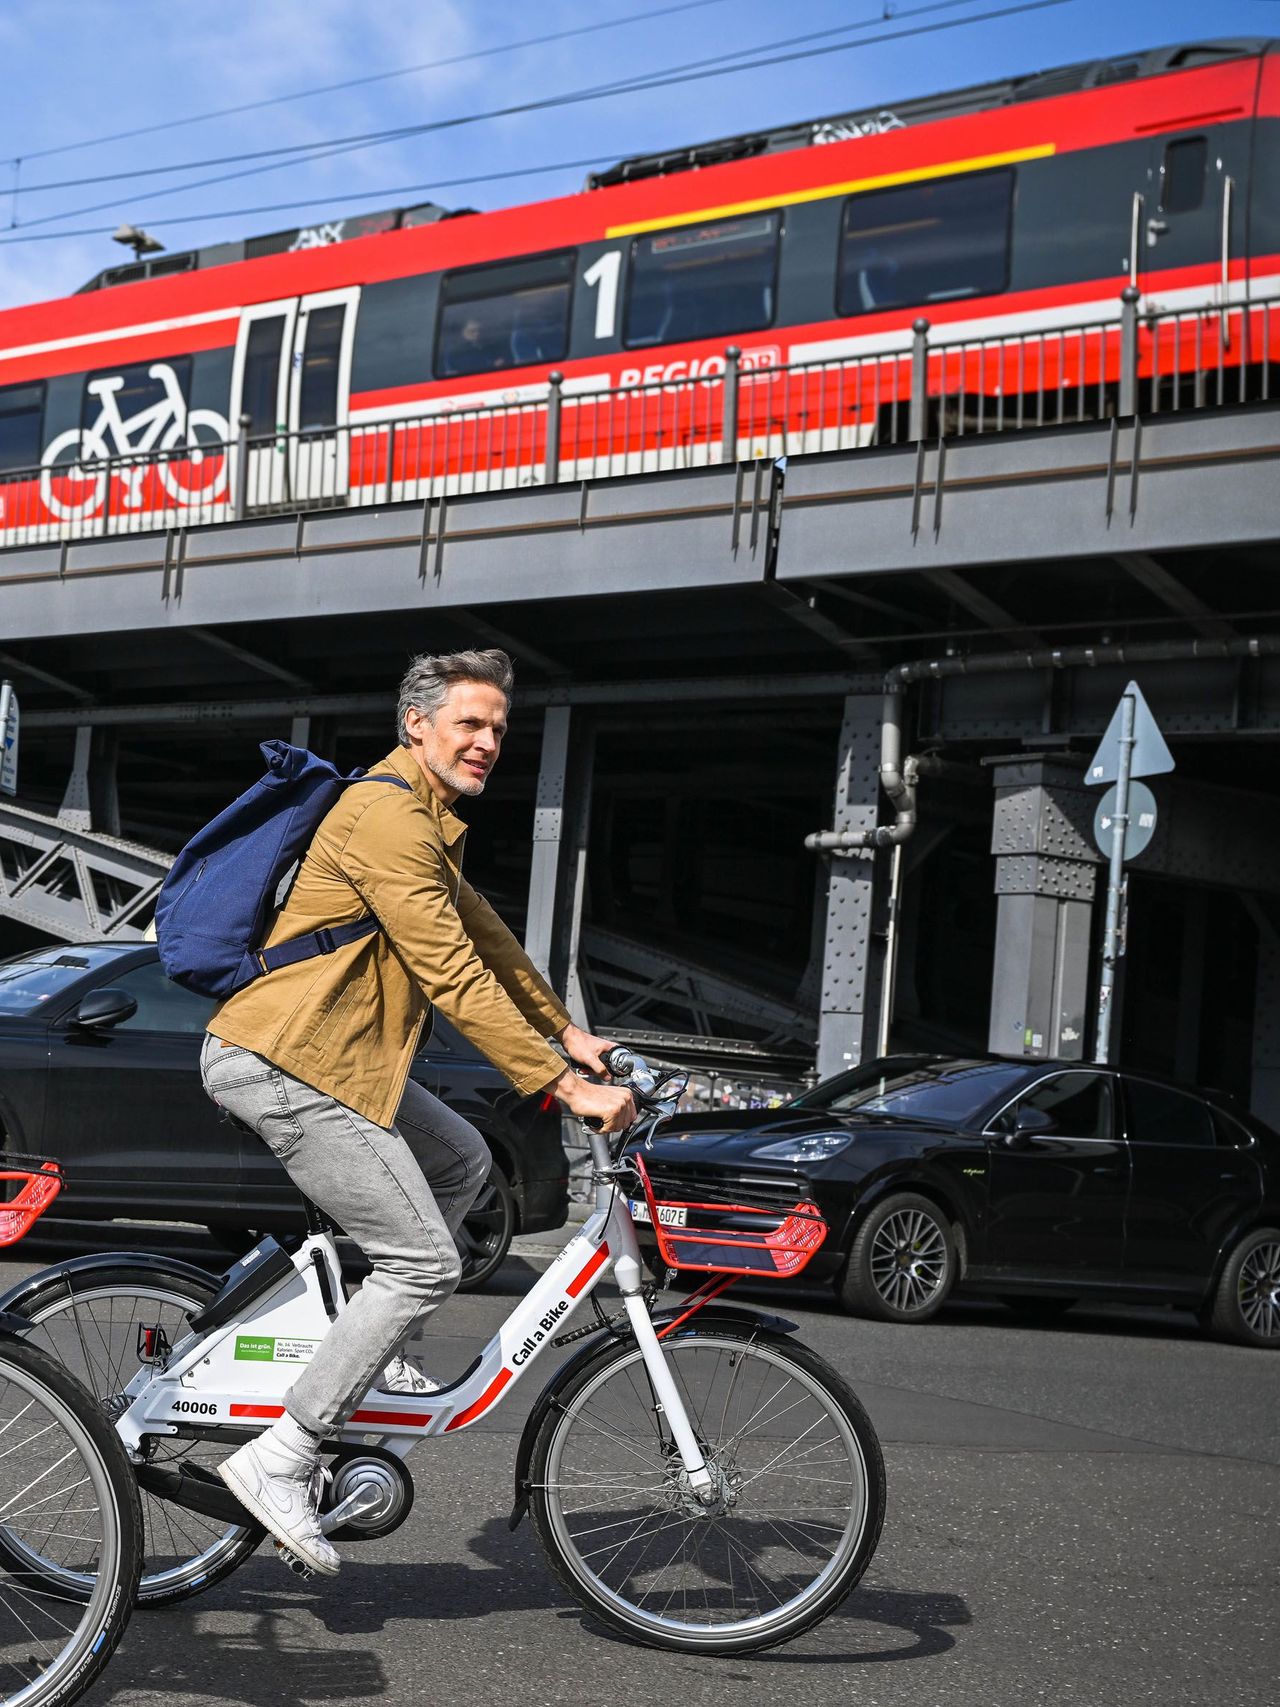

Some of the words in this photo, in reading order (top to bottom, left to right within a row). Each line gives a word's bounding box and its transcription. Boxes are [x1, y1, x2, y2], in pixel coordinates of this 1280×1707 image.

[583, 250, 621, 339] 1
[617, 356, 726, 400] REGIO
[632, 1203, 639, 1217] B
[656, 1207, 685, 1225] 607E
[538, 1300, 569, 1332] Bike
[533, 1330, 545, 1342] a
[512, 1337, 538, 1366] Call
[171, 1400, 217, 1415] 40006
[104, 1584, 122, 1630] SCHWALBE
[80, 1653, 94, 1673] DELTA
[60, 1671, 81, 1695] CRUISER
